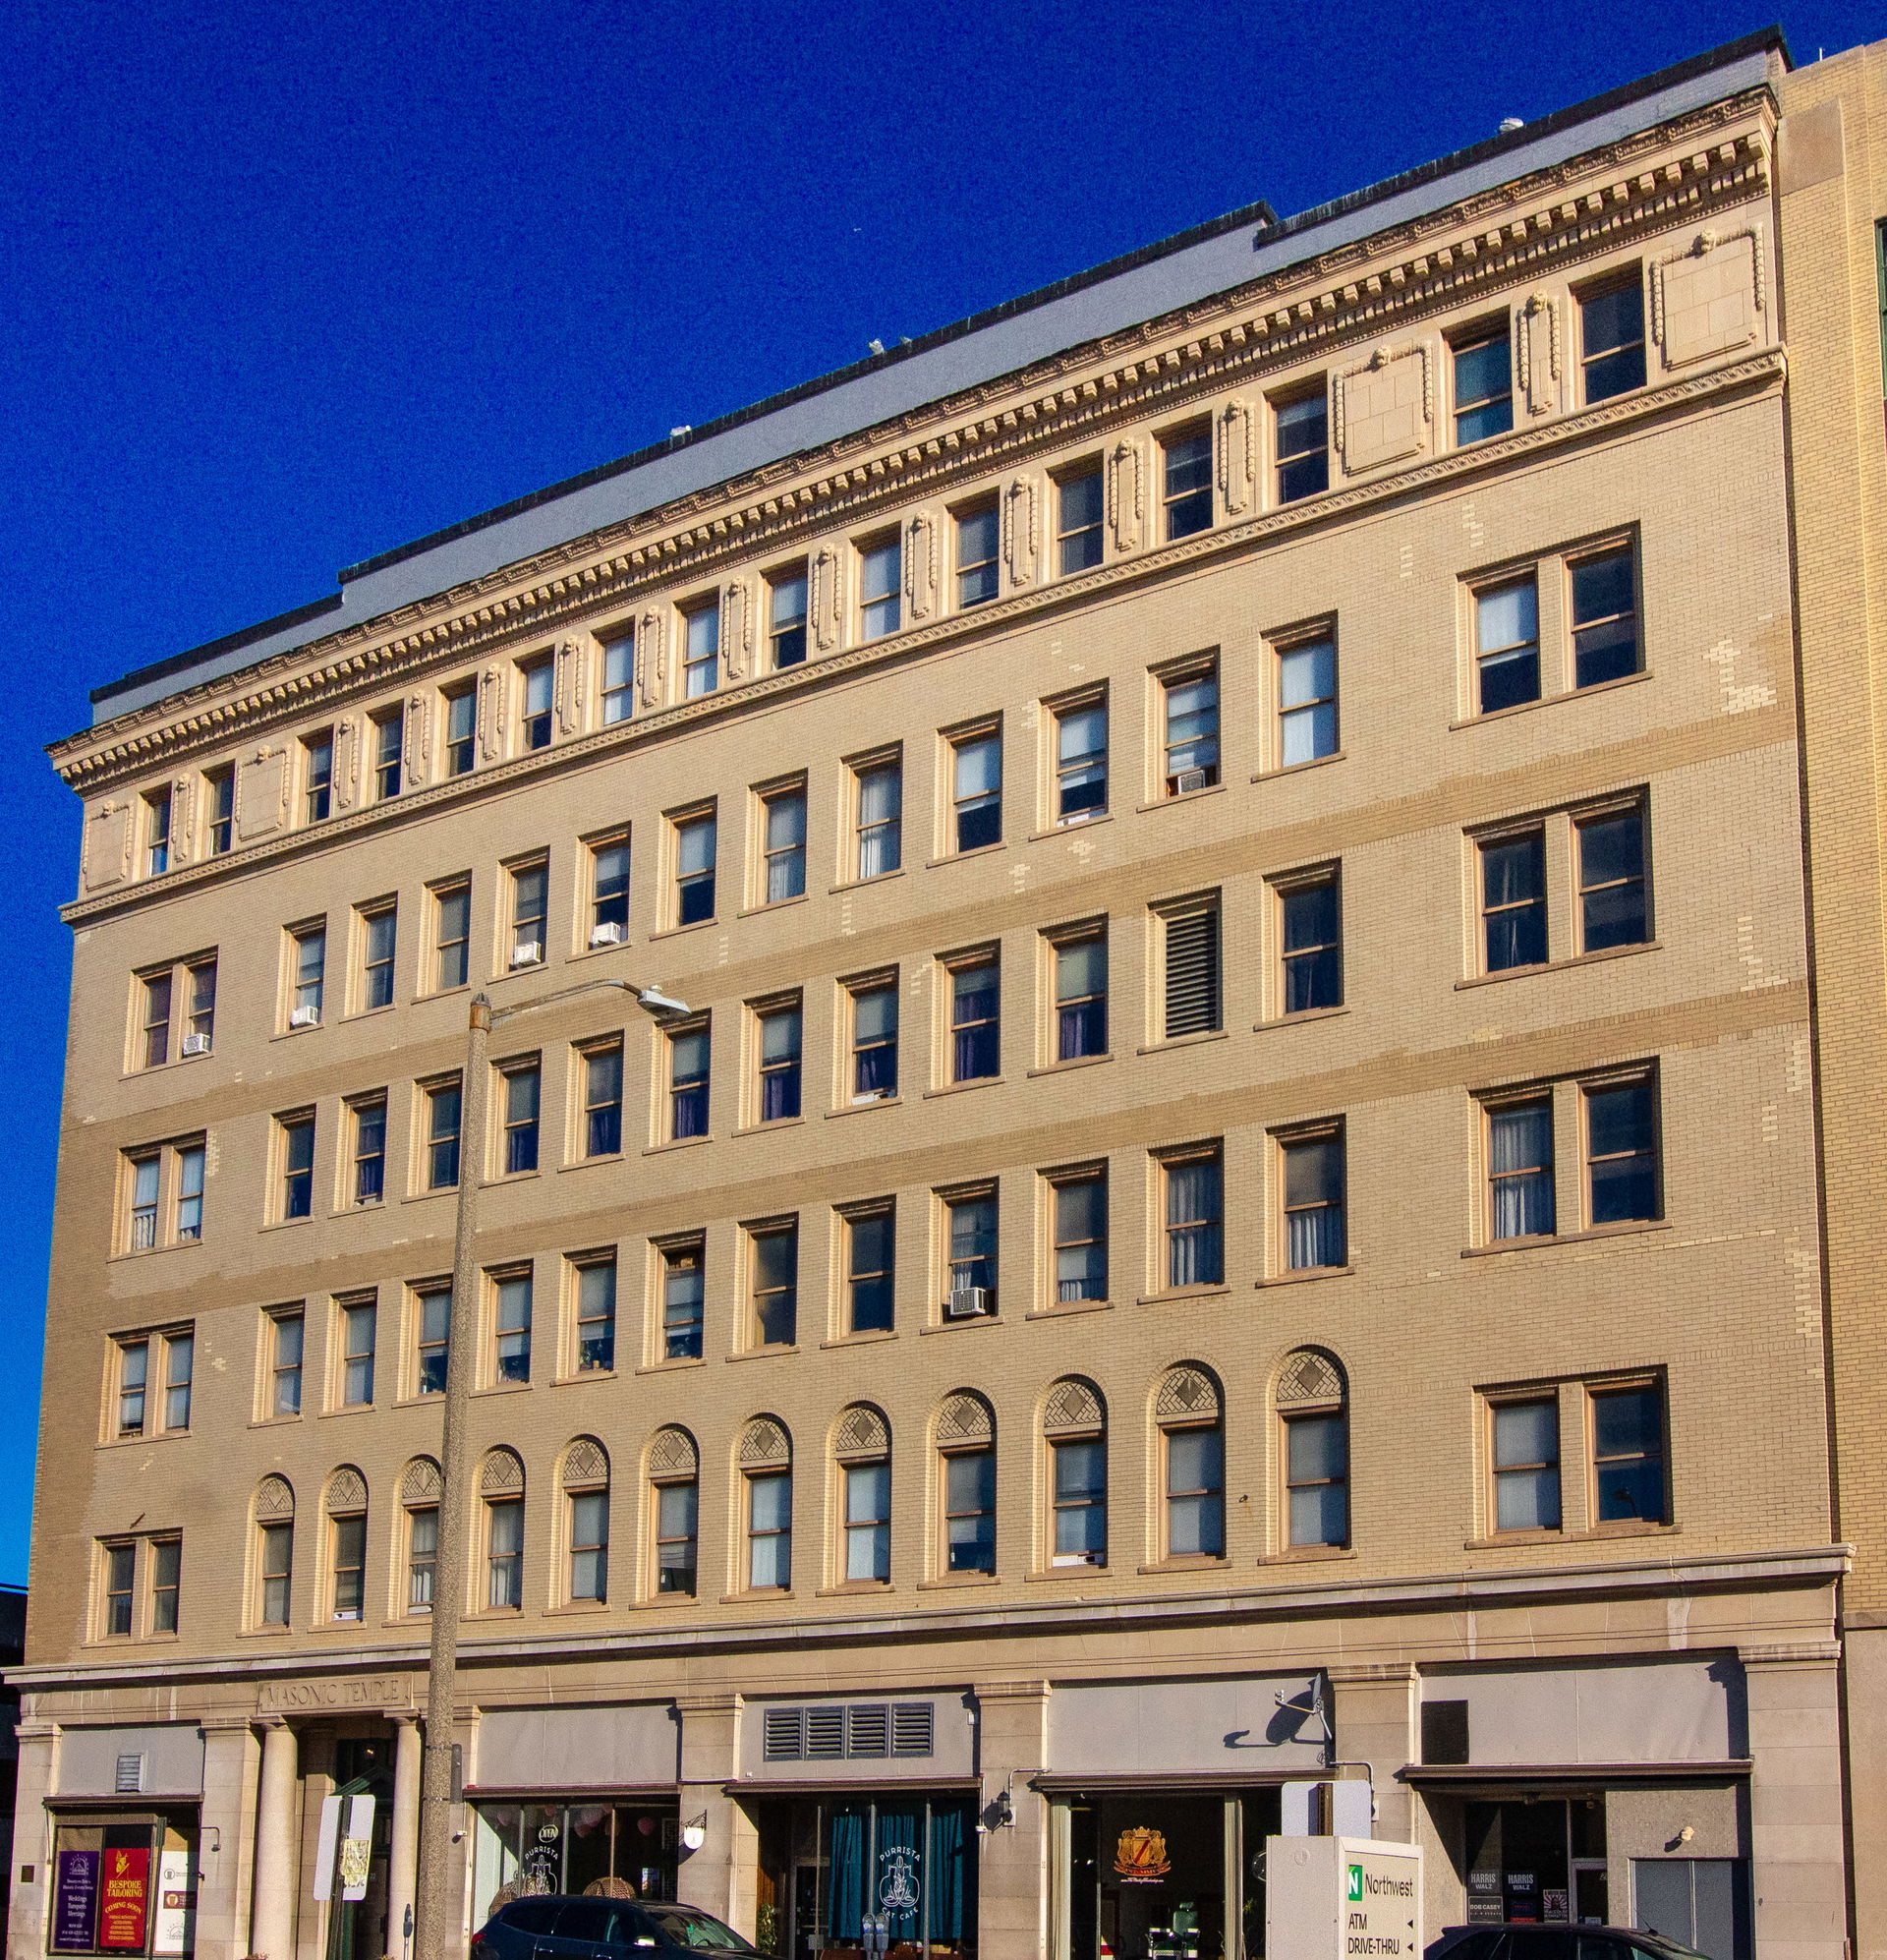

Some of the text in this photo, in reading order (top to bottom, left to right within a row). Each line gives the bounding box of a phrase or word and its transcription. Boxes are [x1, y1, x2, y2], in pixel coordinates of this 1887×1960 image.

[267, 1680, 399, 1706] MASONIC TEMPLE
[525, 1846, 558, 1860] PURRISTA
[880, 1847, 921, 1862] PURRISTA
[109, 1879, 142, 1889] BESPOKE
[1365, 1874, 1413, 1897] Northwest
[1470, 1873, 1496, 1884] HARRIS
[1508, 1874, 1534, 1884] HARRIS
[107, 1888, 143, 1898] TAILORING
[104, 1901, 143, 1914] COMING SOON
[882, 1907, 919, 1921] CAT CAFE
[1348, 1913, 1367, 1931] ATM
[1347, 1936, 1400, 1955] DRIVE-THRU
